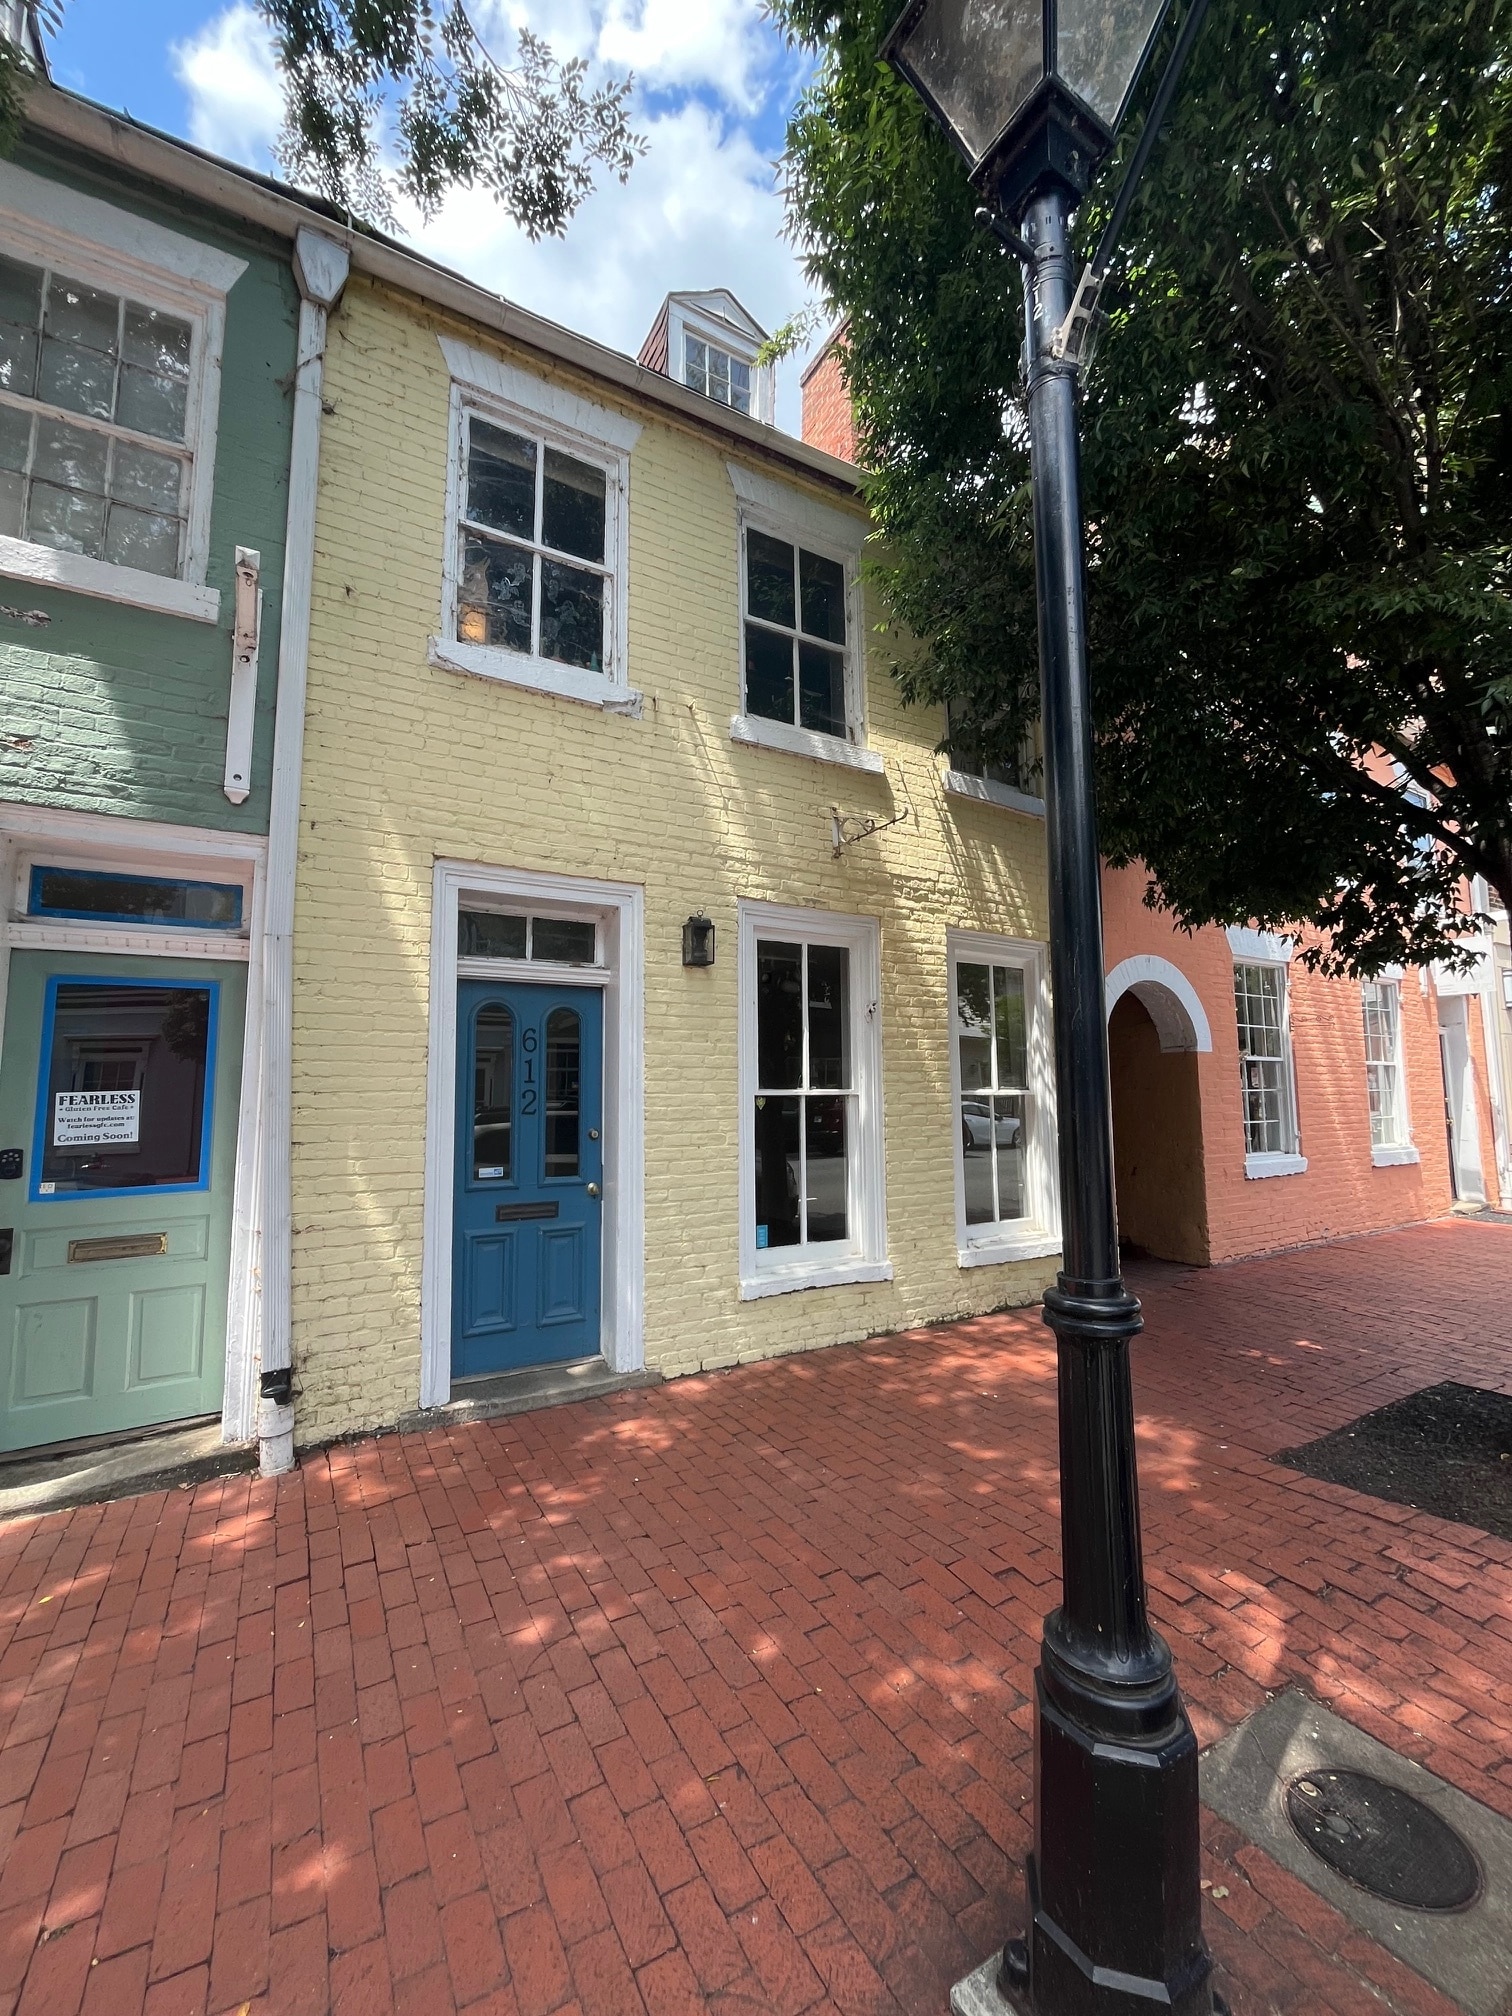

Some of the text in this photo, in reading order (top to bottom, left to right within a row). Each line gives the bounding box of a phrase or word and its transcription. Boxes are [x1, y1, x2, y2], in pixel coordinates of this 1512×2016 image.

[521, 1027, 538, 1115] 612
[58, 1093, 136, 1106] FEARLESS
[57, 1132, 133, 1142] Coming Soon!
